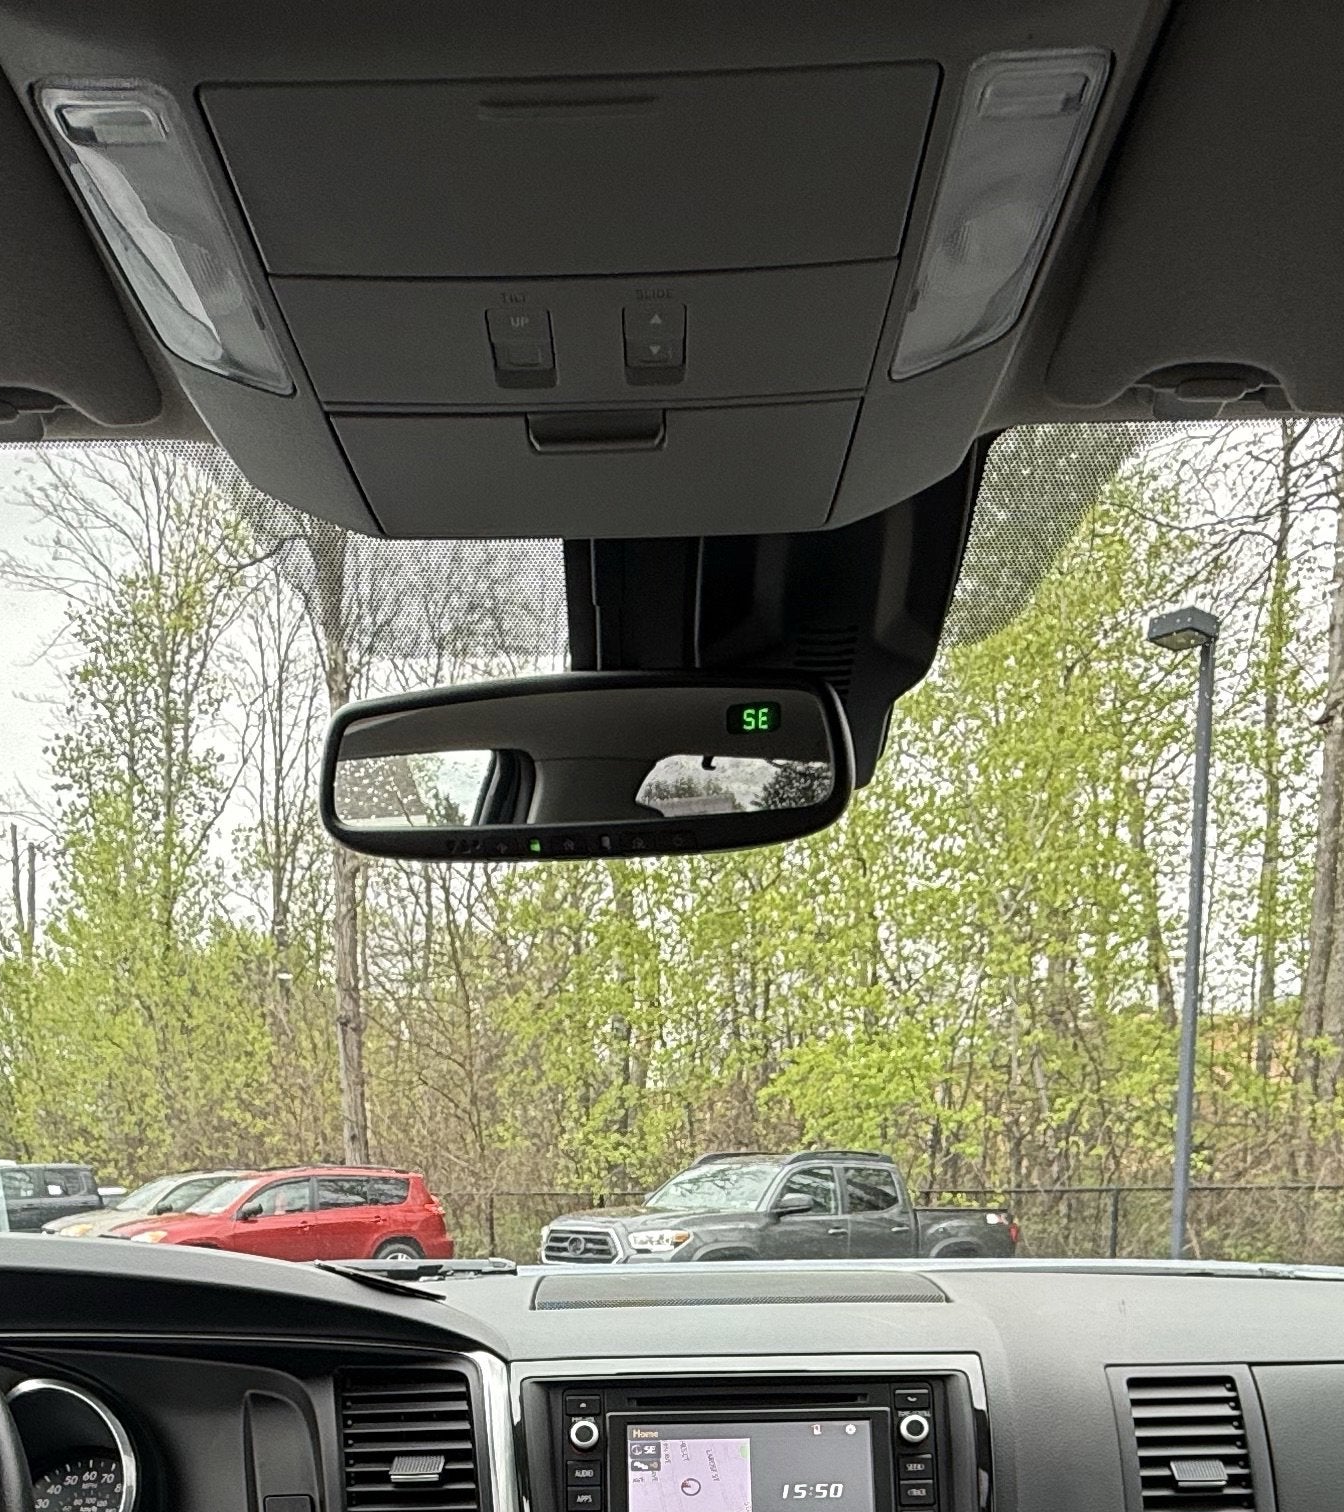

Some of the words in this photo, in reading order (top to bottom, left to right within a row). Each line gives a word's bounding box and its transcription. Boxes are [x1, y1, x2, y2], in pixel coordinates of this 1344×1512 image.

[510, 317, 530, 328] UP
[743, 708, 769, 730] SE
[632, 1429, 659, 1439] Home
[64, 1475, 78, 1486] 50
[82, 1471, 97, 1482] 60
[100, 1473, 115, 1484] 70
[47, 1484, 62, 1495] 40
[782, 1483, 844, 1499] 15:50
[35, 1498, 50, 1509] 30
